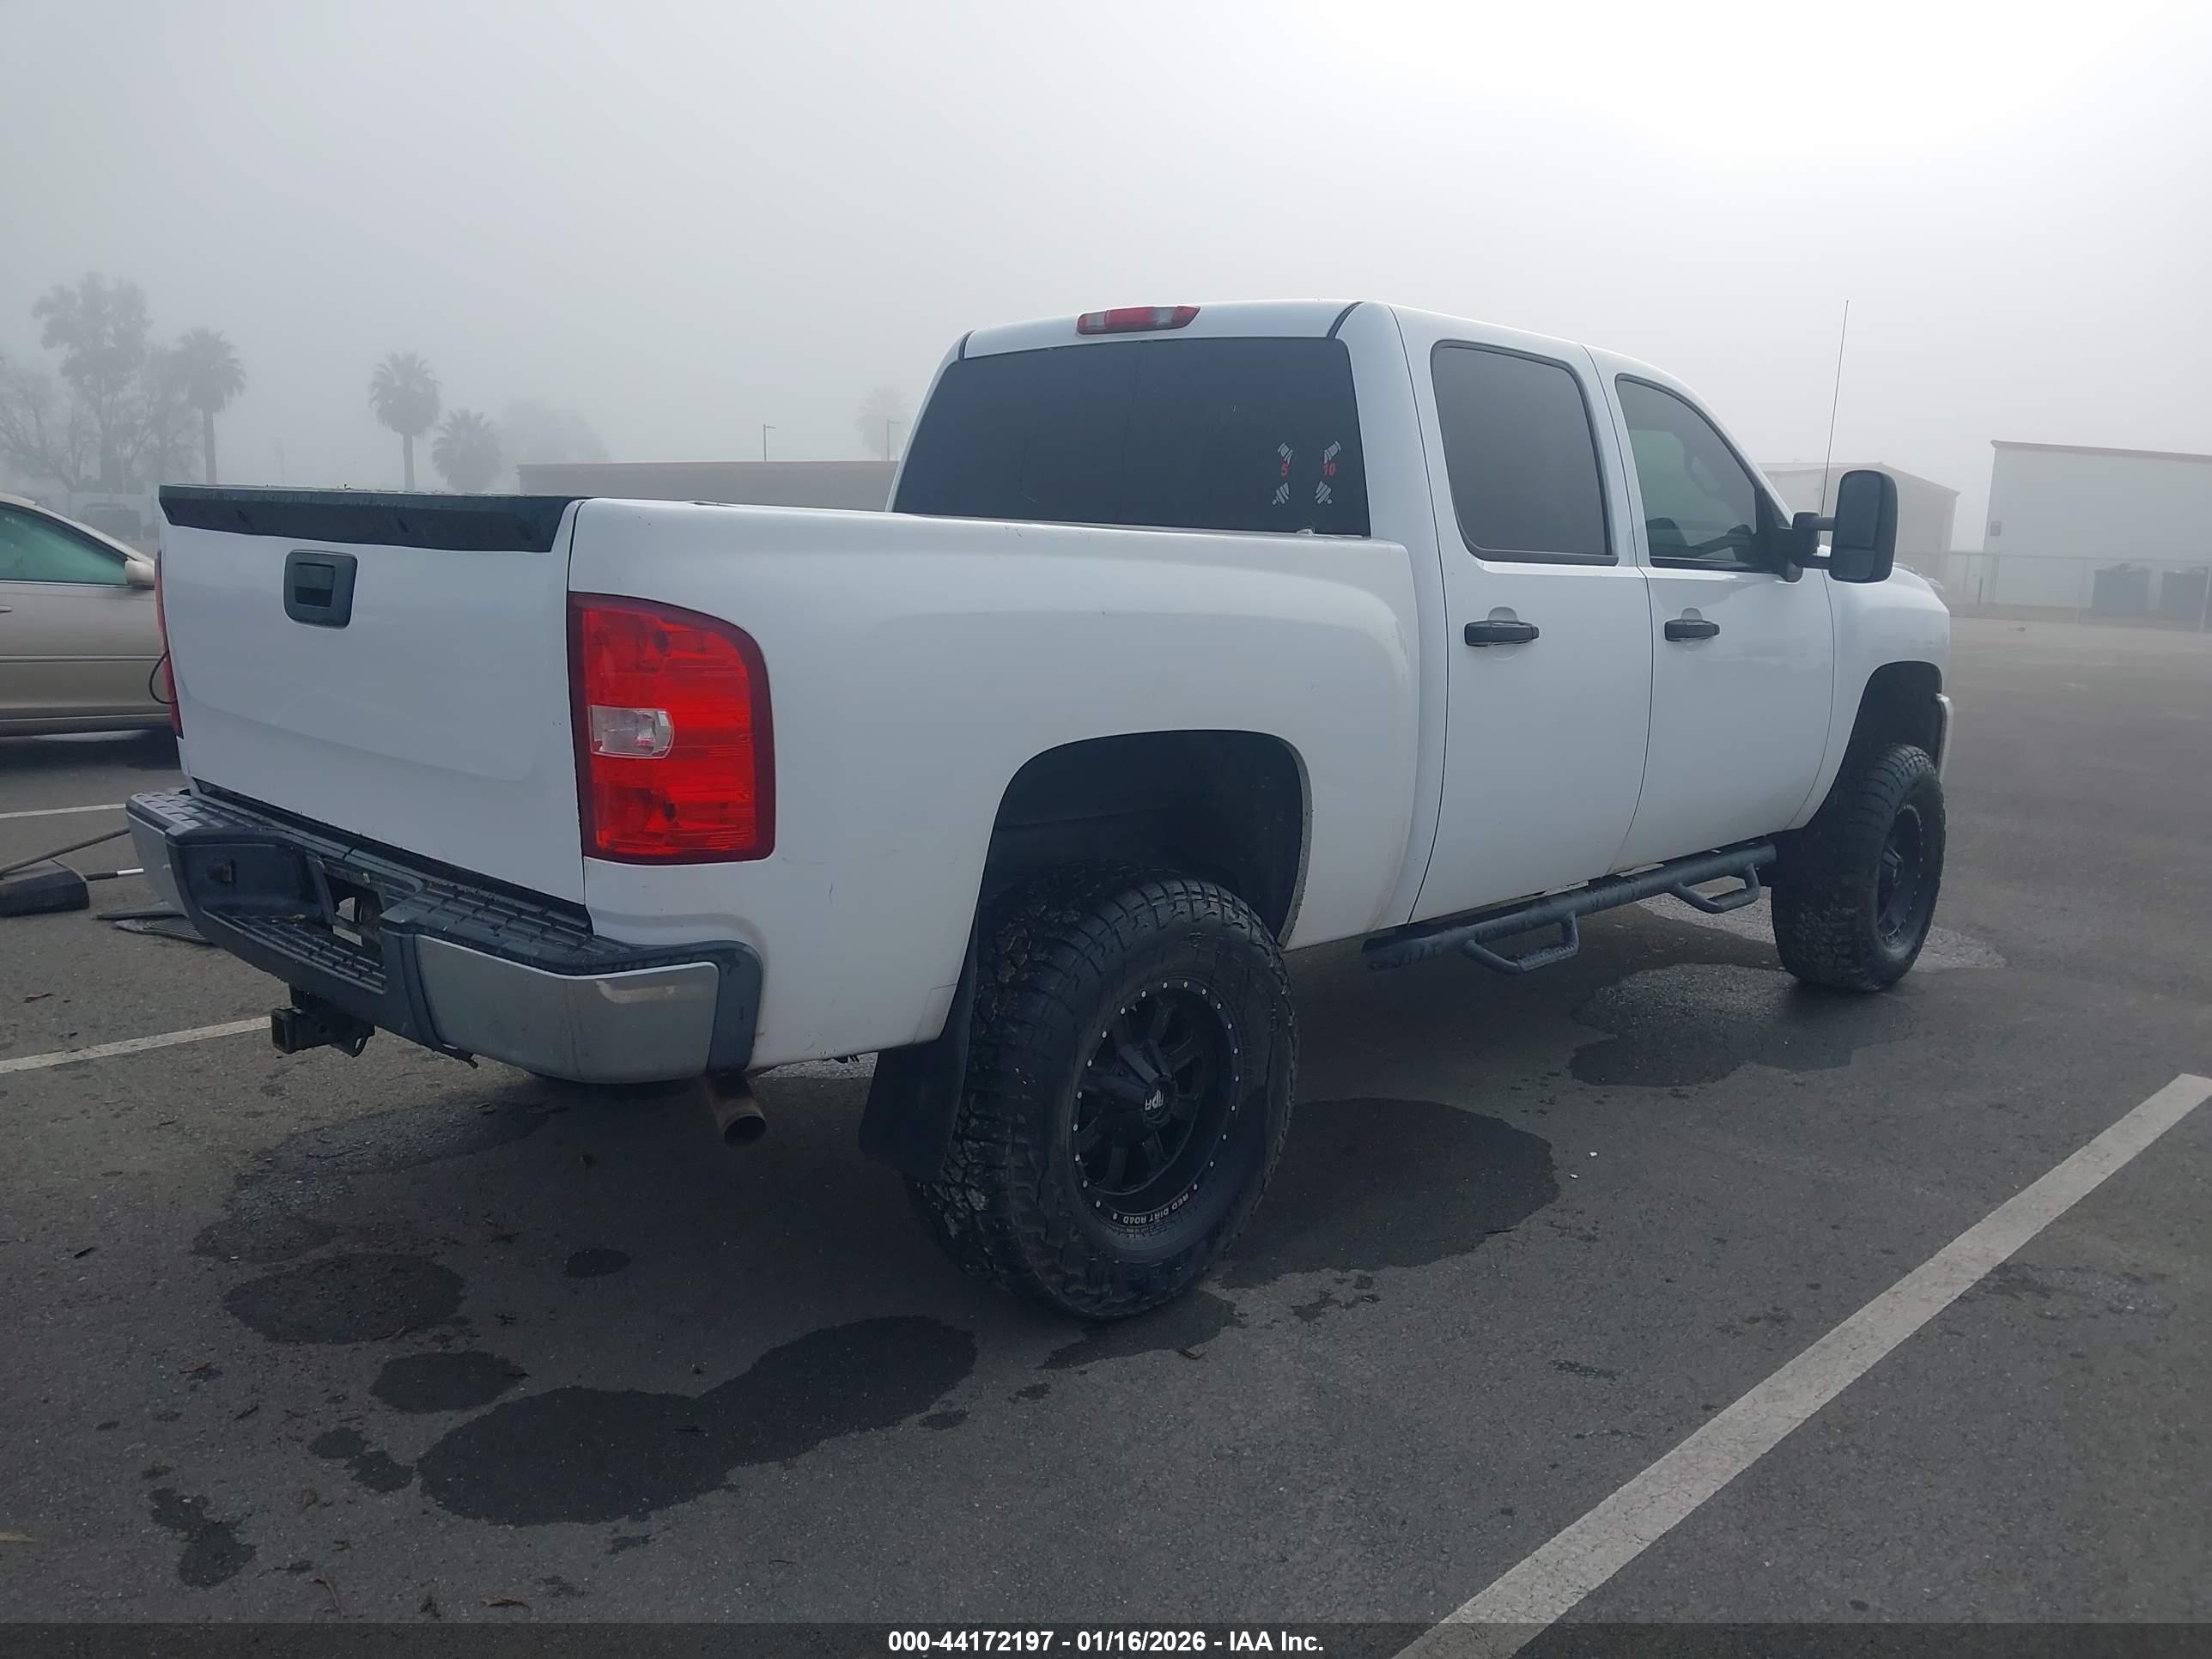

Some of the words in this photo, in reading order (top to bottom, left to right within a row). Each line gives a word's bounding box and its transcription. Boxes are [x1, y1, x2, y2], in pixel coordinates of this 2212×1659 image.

[1280, 463, 1289, 476] 5
[1323, 463, 1335, 476] 10
[1122, 1216, 1147, 1224] ROAD
[1149, 1209, 1170, 1222] DIRT
